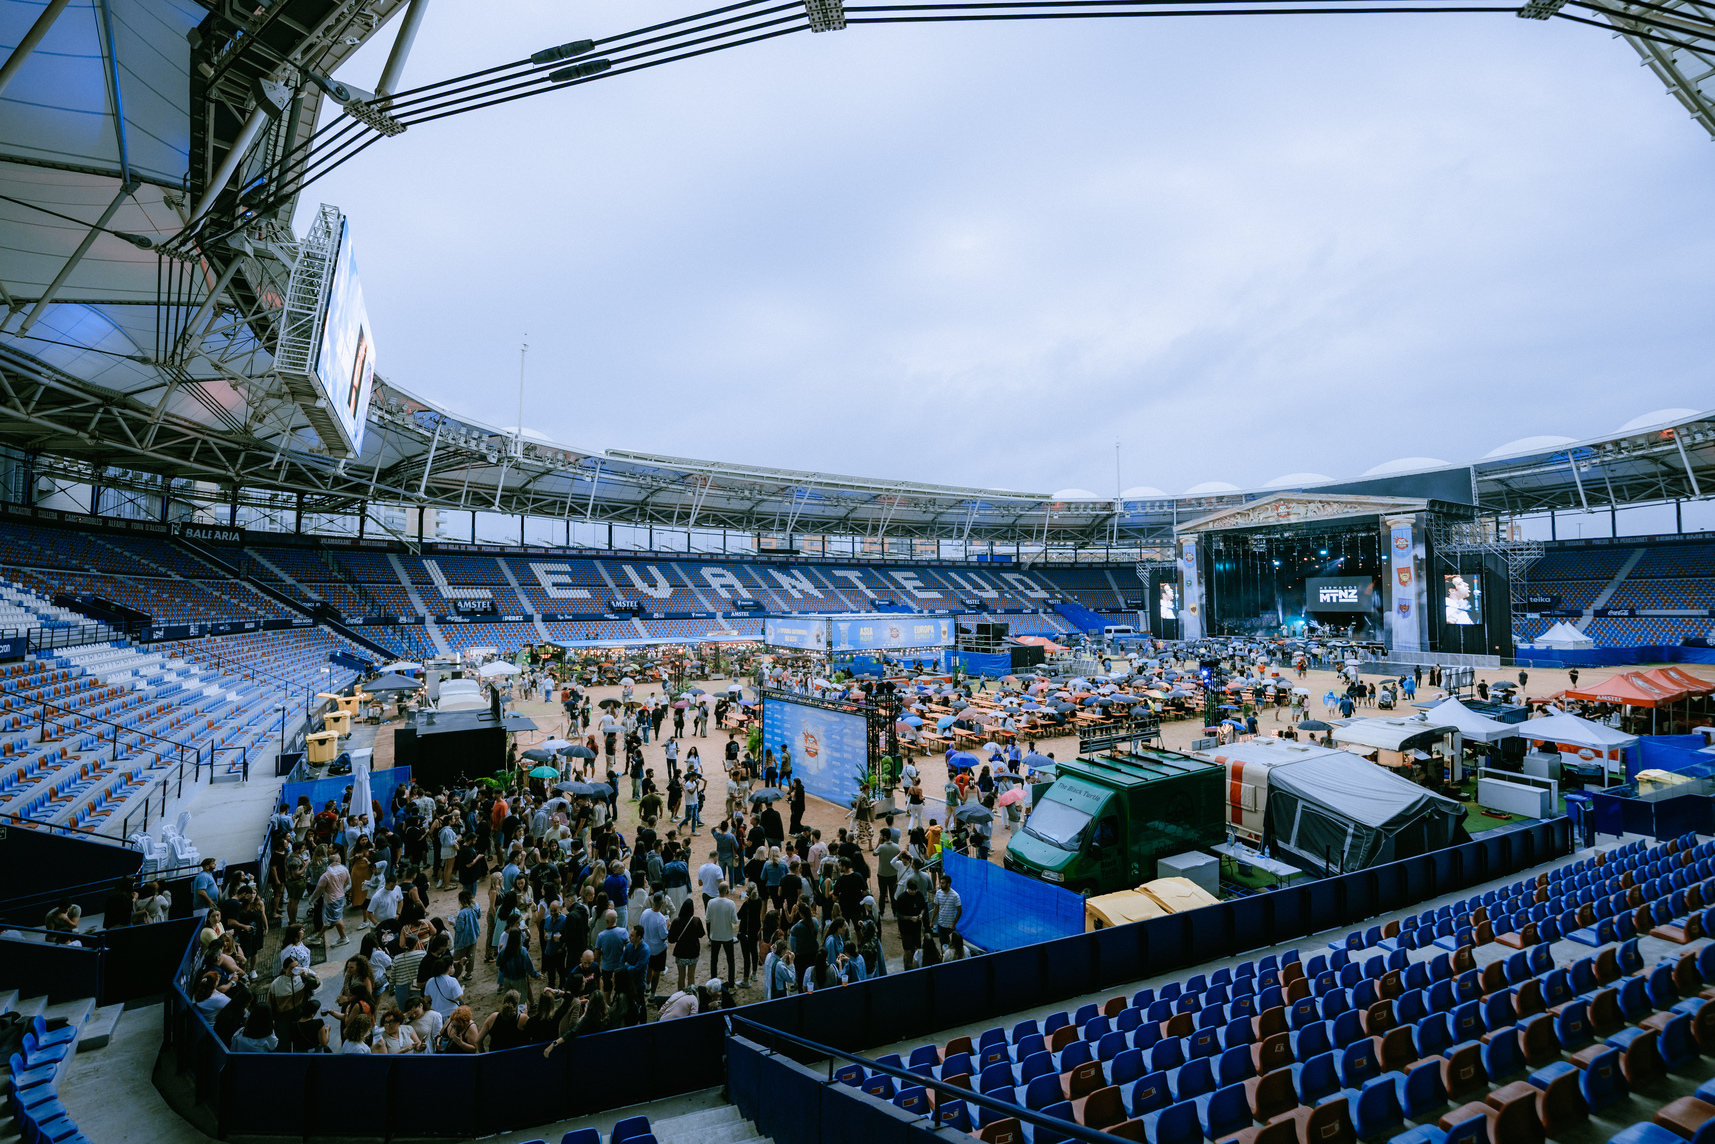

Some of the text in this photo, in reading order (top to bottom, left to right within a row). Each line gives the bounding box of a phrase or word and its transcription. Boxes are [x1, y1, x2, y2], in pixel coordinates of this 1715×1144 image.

[1319, 589, 1358, 603] MTNZ
[457, 601, 492, 609] AMSTEL
[610, 600, 638, 608] AMSTEL
[859, 627, 874, 636] ASIA
[913, 625, 935, 634] EUROPA
[1595, 694, 1623, 703] AMSTEL
[1058, 782, 1101, 801] The Black Turtle
